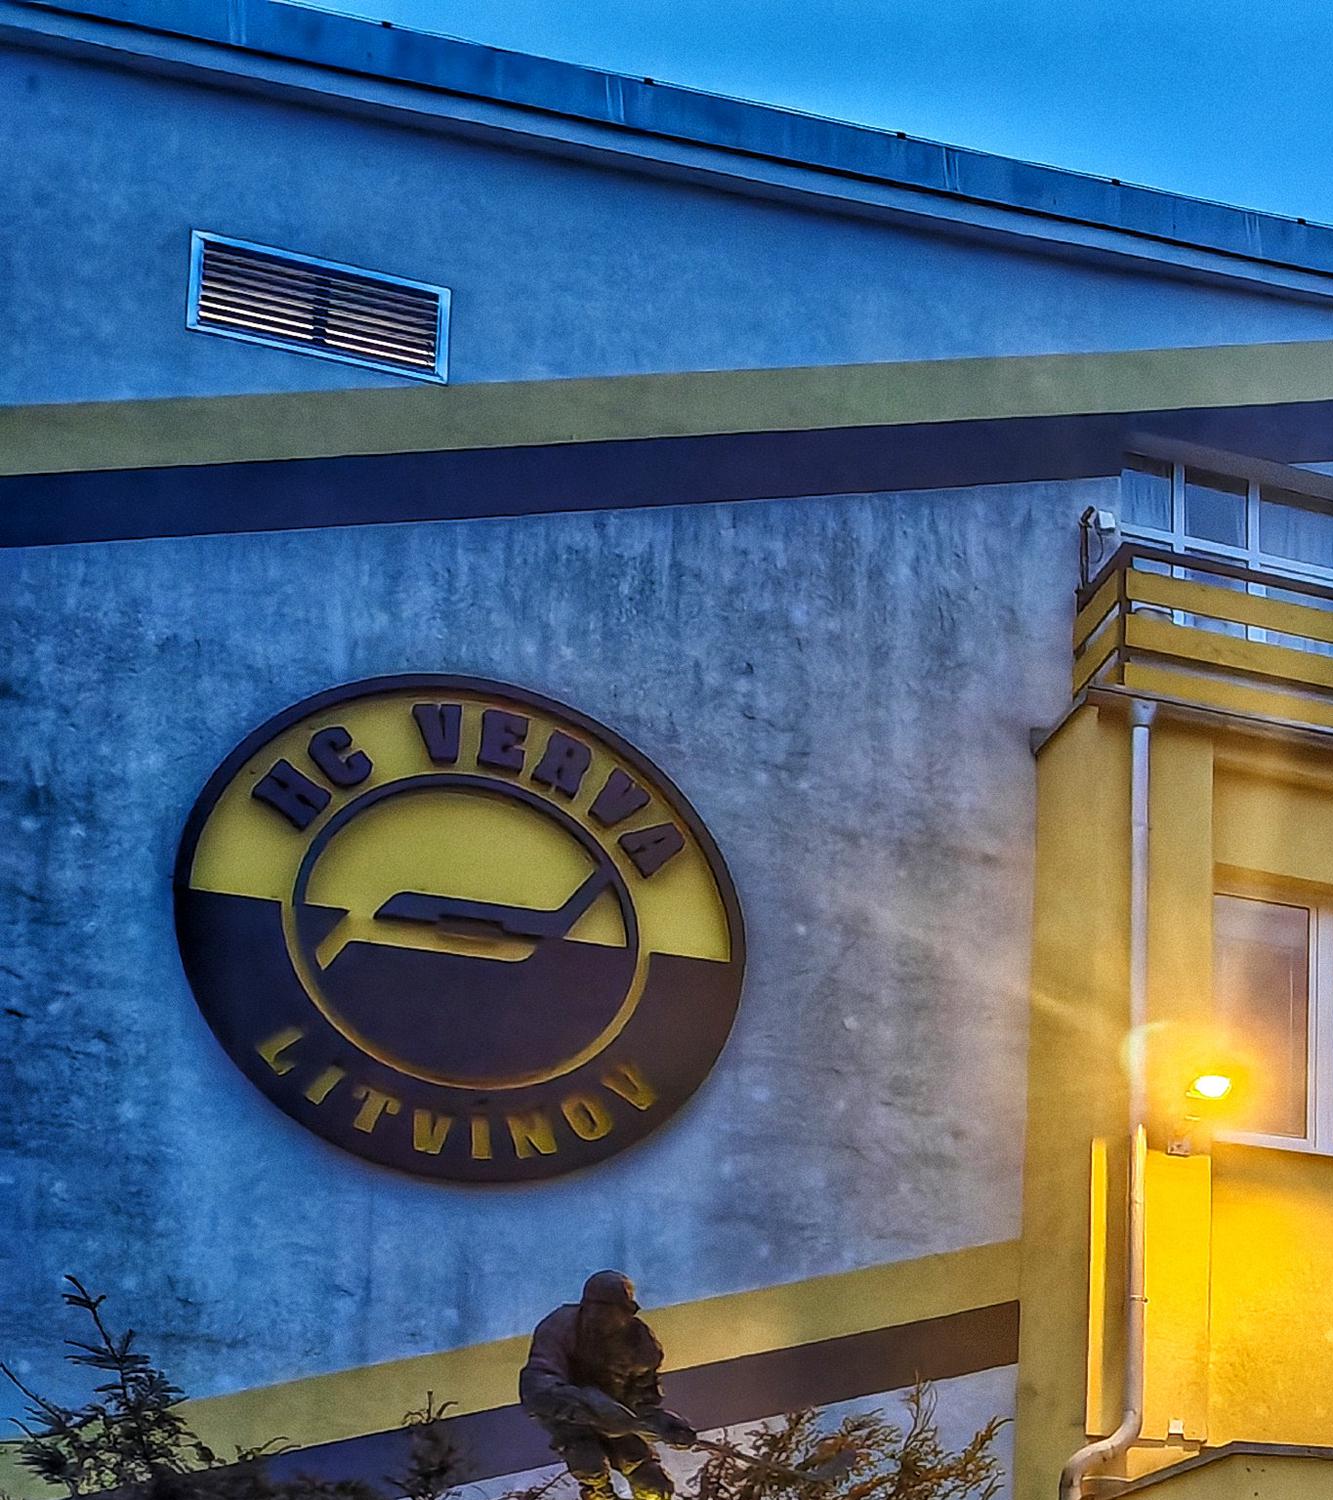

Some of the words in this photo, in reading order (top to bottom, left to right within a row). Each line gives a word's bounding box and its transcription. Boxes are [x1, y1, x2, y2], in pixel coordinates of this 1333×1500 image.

[252, 725, 373, 831] HC
[411, 702, 686, 879] VERVA
[256, 1026, 656, 1160] LITVINOV
